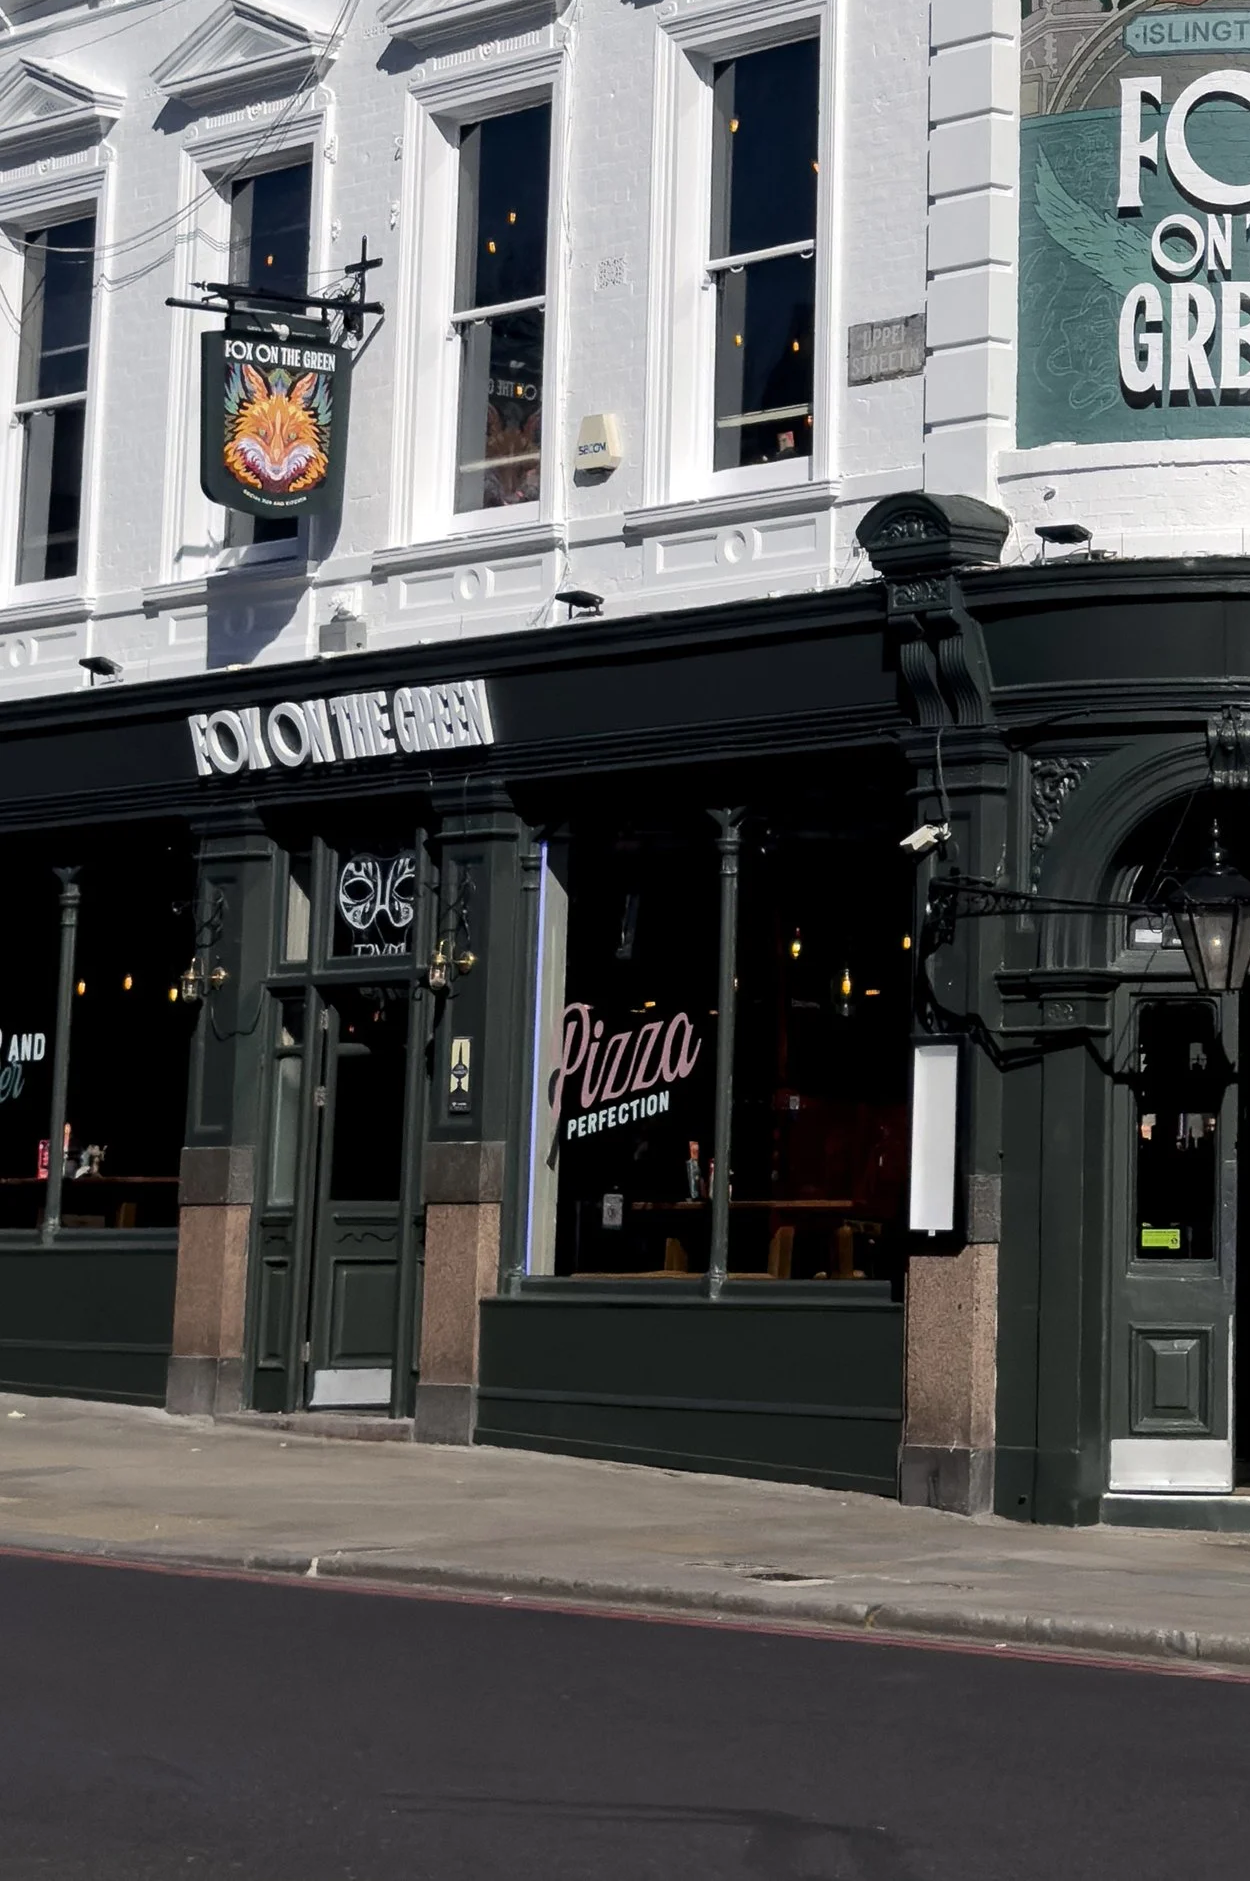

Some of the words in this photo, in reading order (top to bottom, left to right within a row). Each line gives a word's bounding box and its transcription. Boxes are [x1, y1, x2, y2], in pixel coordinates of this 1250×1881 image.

[1151, 213, 1232, 278] ON
[225, 340, 253, 361] FOX
[256, 344, 278, 364] ON
[281, 347, 301, 367] THE
[303, 350, 336, 372] GREEN
[188, 707, 271, 776] FOX
[267, 699, 336, 767] ON
[329, 690, 397, 760] THE
[393, 679, 494, 753] GREEN
[8, 1033, 46, 1062] AND
[552, 1002, 702, 1124] Pizza
[567, 1090, 670, 1140] PERFECTION
